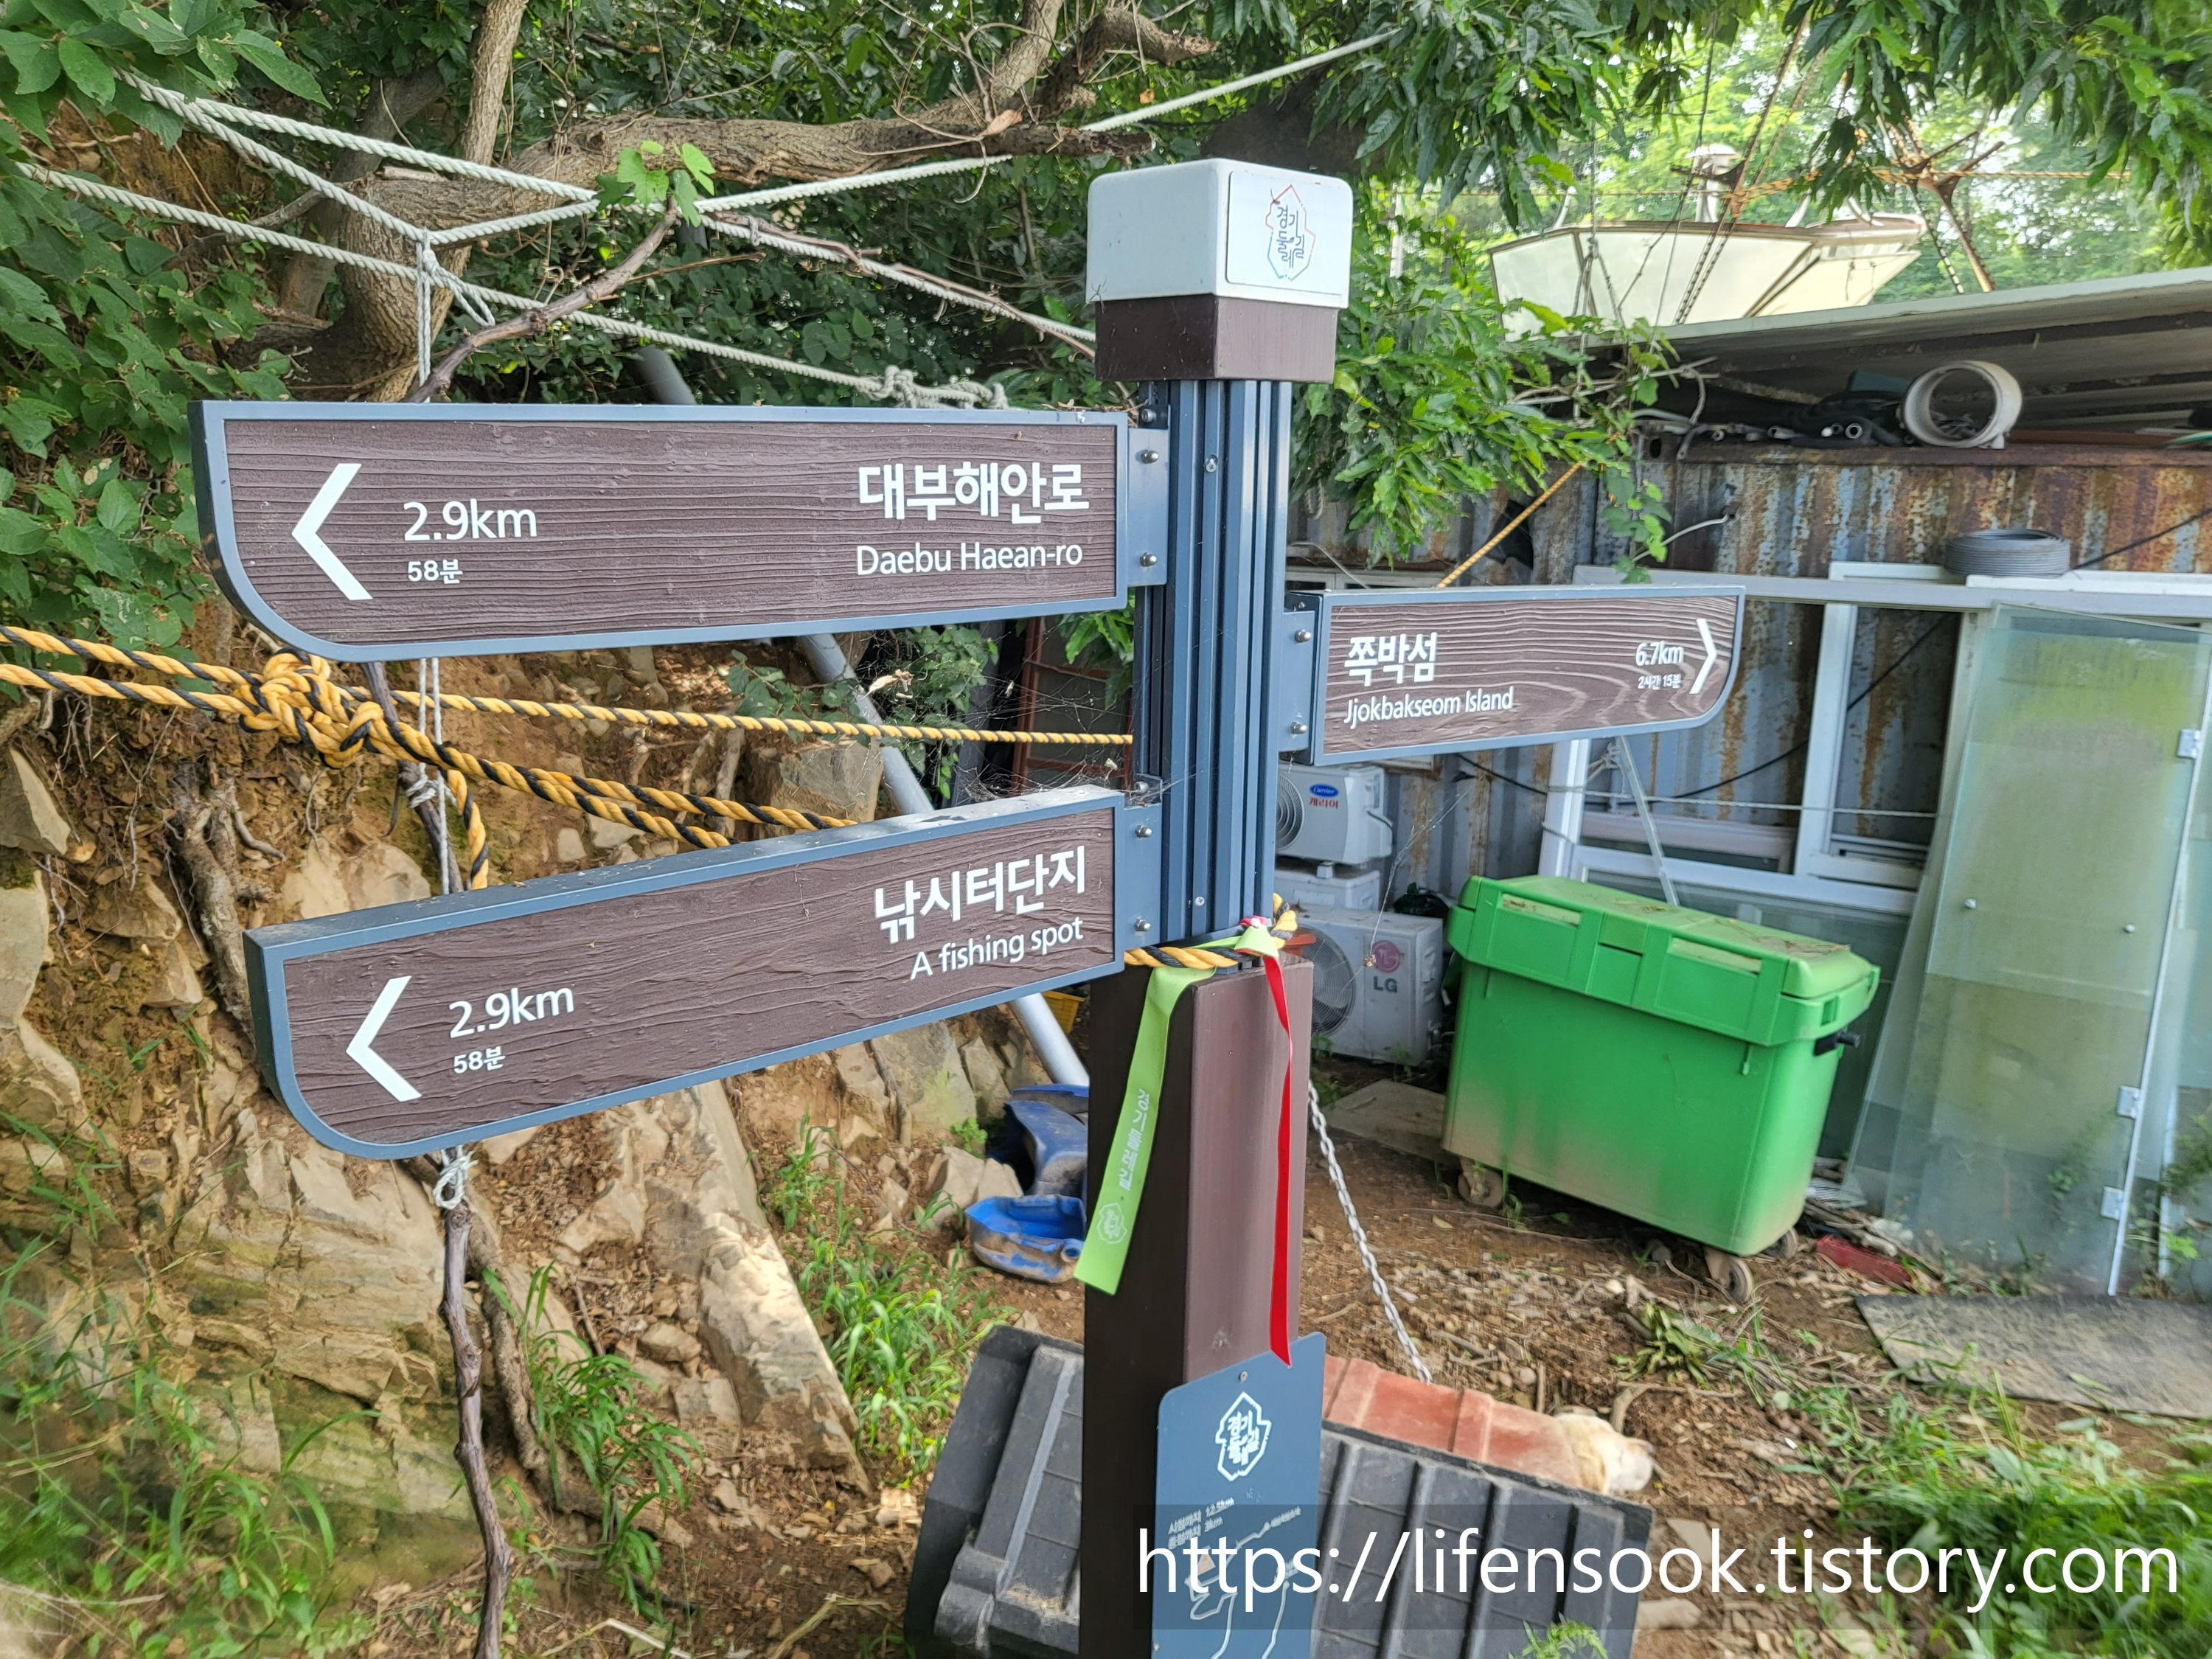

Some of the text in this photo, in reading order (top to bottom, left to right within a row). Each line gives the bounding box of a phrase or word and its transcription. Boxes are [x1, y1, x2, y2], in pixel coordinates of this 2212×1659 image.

[858, 461, 1090, 524] 대부해안로
[403, 498, 538, 542] 2.9km
[406, 559, 463, 585] 58분
[856, 541, 1083, 575] Daebu Haean-ro
[1344, 632, 1438, 686] 쪽박섬
[1635, 640, 1684, 666] 6.7km
[1637, 673, 1682, 690] 2시간 15분
[1343, 685, 1514, 729] Jjokbakseom Island
[874, 845, 1085, 945] 낚시터단지
[910, 916, 1084, 981] A fishing spot
[1373, 975, 1398, 993] LG
[448, 987, 574, 1038] 2.9km
[453, 1046, 506, 1074] 58분
